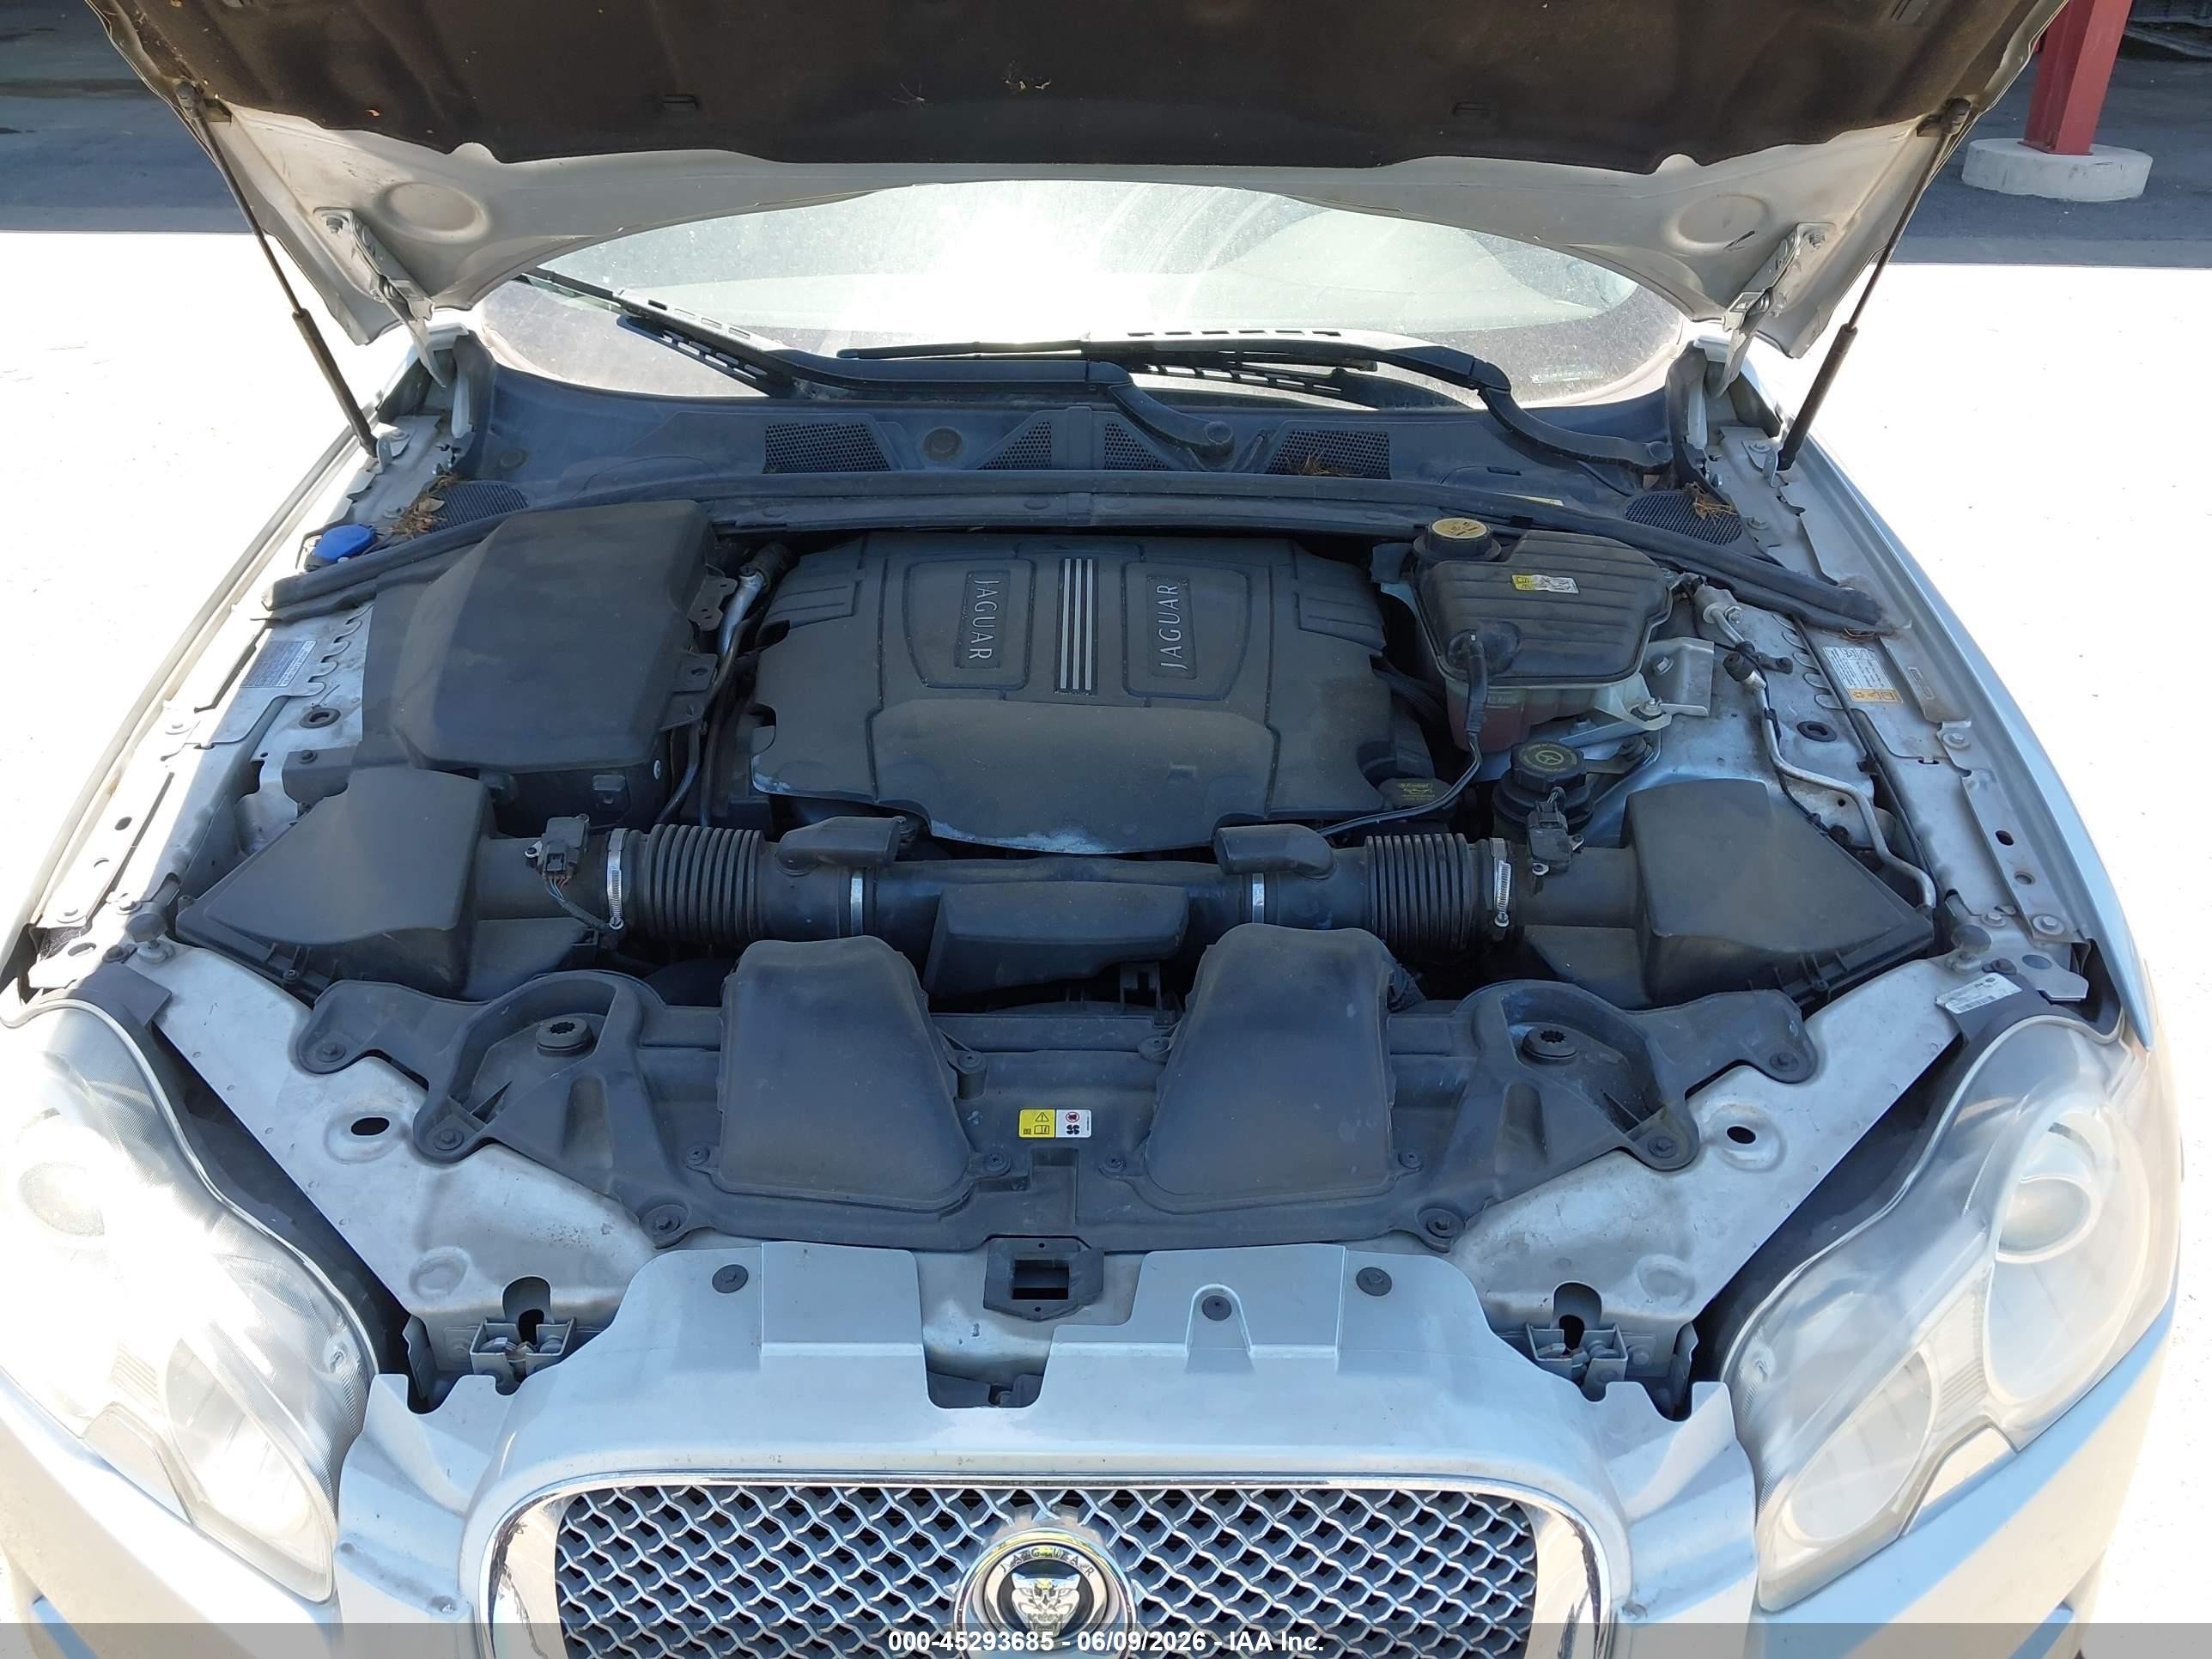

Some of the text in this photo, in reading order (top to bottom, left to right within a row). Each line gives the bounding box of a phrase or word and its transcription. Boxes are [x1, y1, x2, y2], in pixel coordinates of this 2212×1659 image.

[968, 580, 1000, 659] JAGUAR
[1156, 584, 1189, 671] JAGUAR
[1000, 1547, 1096, 1577] JAGUAR
